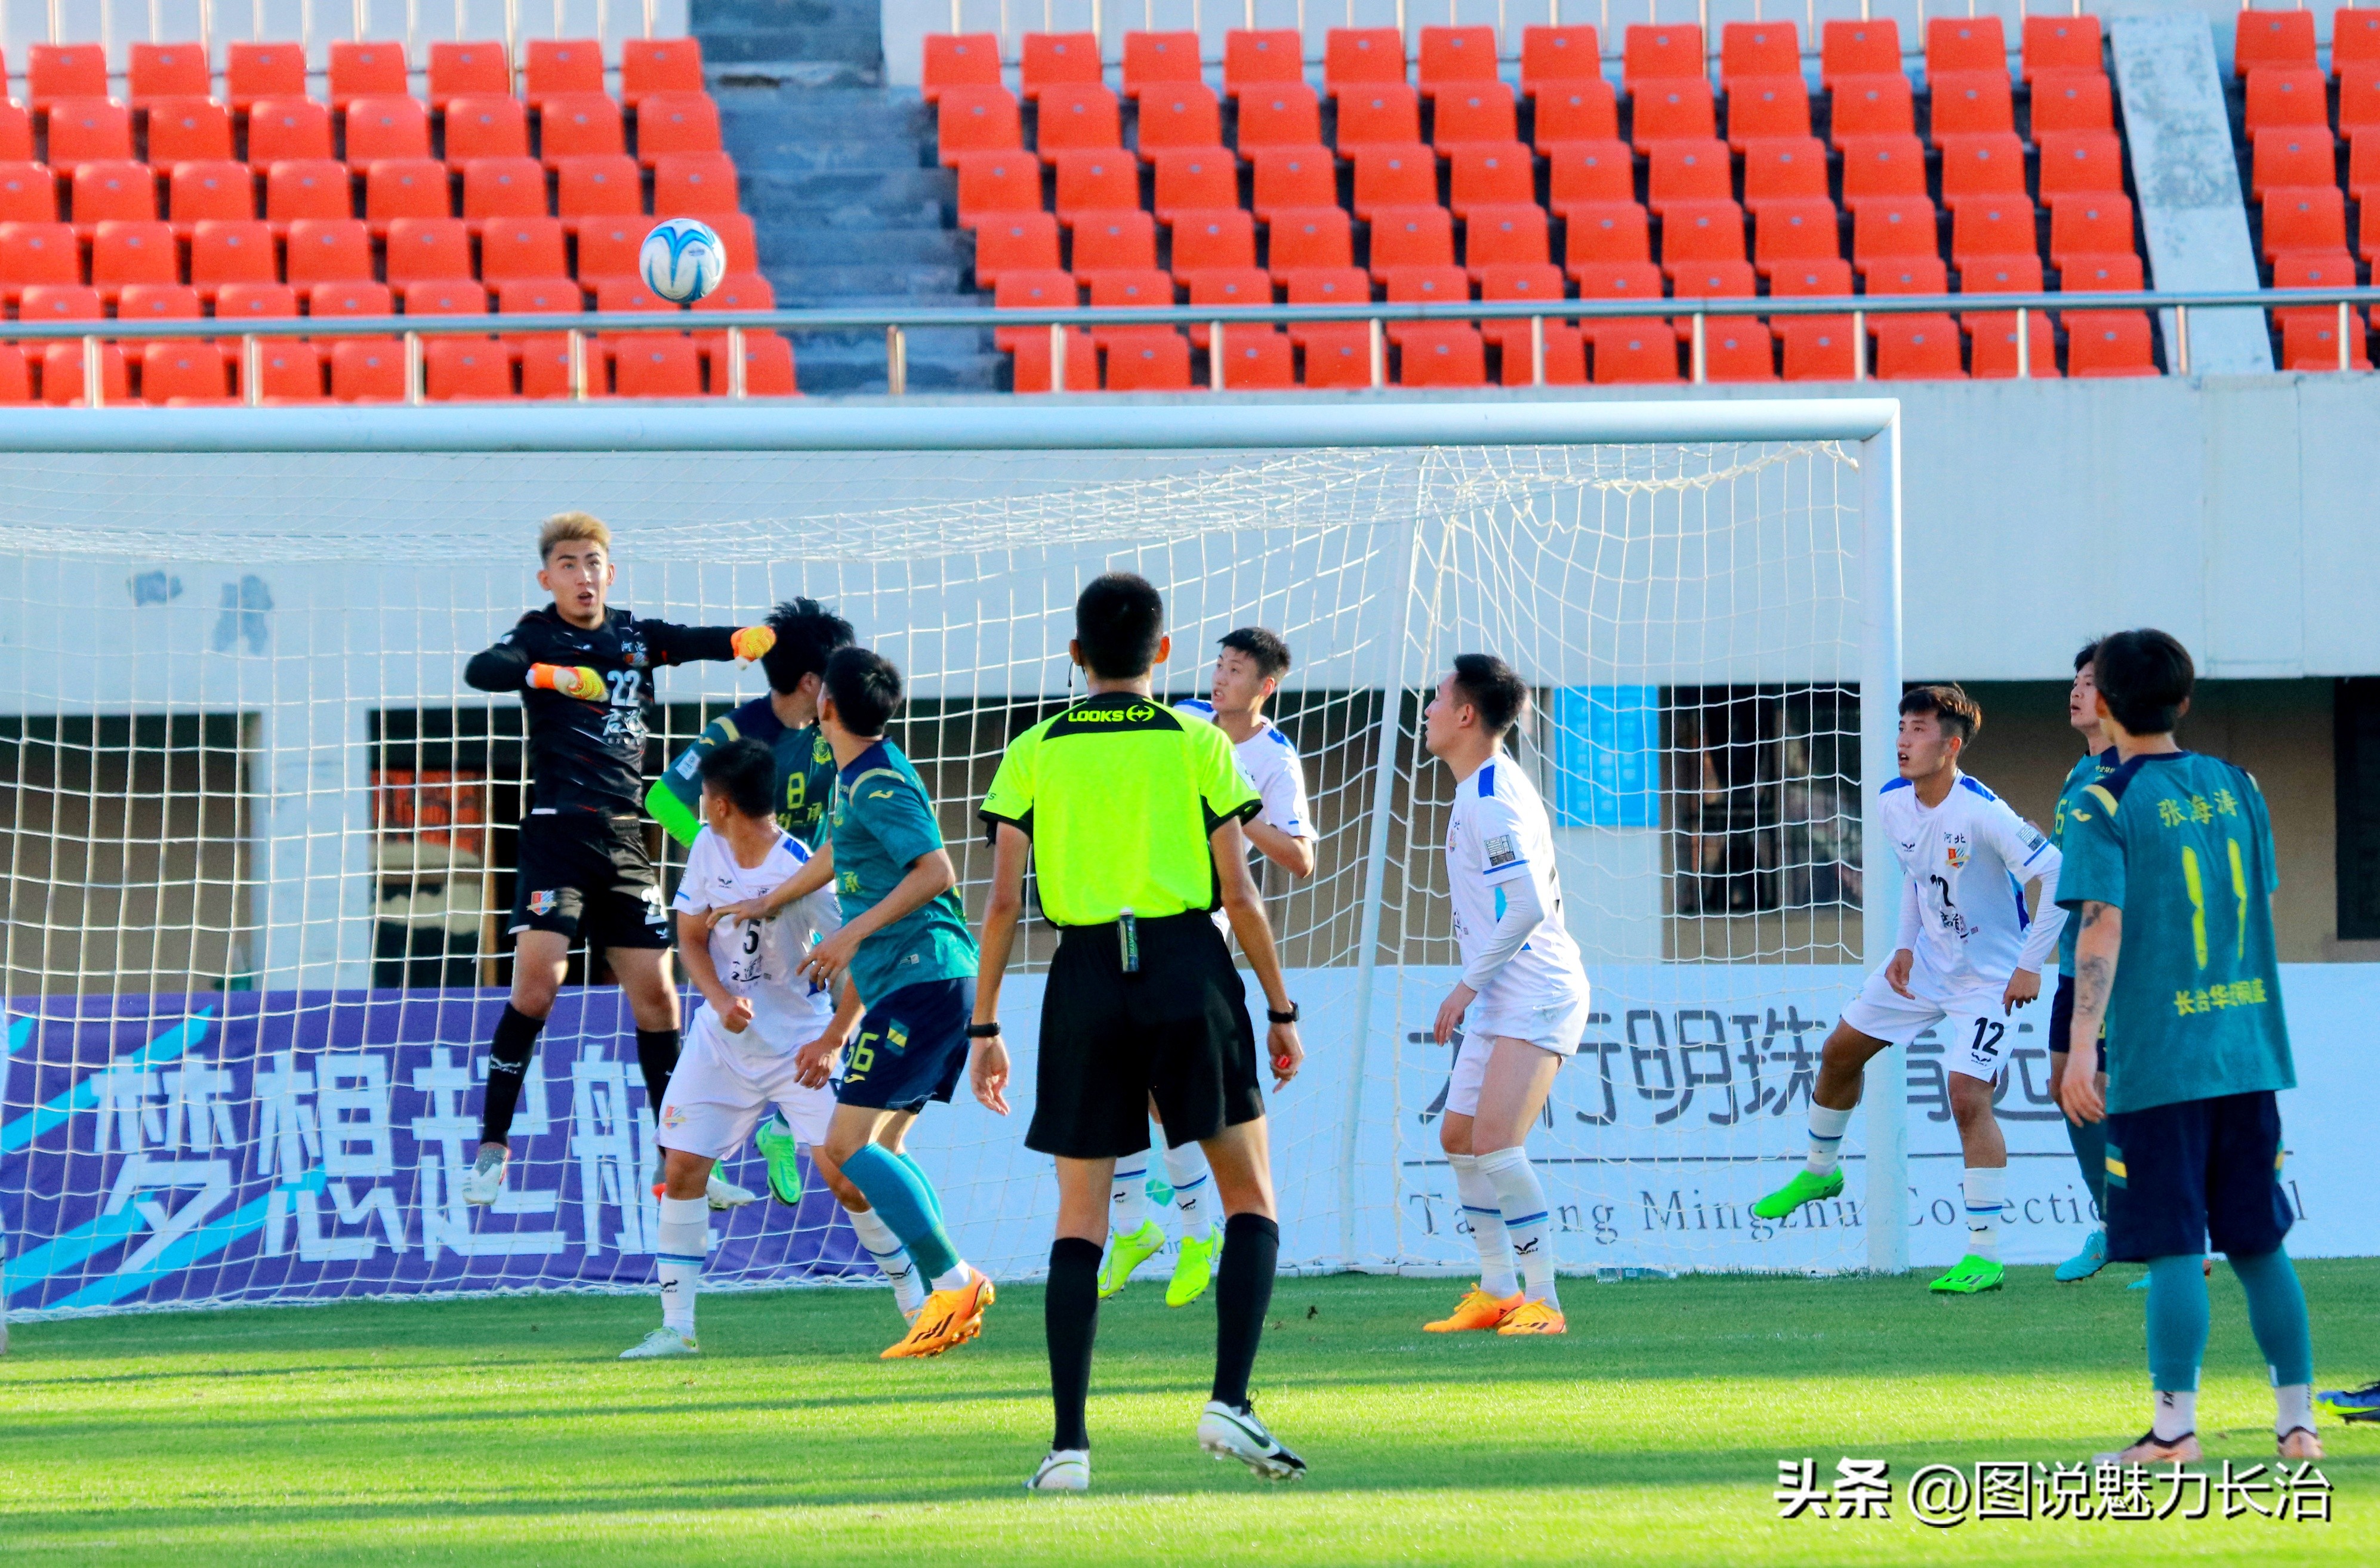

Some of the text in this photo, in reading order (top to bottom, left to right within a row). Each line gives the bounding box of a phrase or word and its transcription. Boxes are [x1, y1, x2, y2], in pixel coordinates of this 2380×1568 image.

[607, 670, 640, 707] 22
[1068, 711, 1124, 723] LOOKS
[787, 772, 805, 810] 8
[2157, 788, 2239, 828] 张海涛
[1943, 832, 1966, 844] 河北
[2182, 837, 2248, 971] 11
[742, 919, 762, 955] 5
[1972, 1017, 2005, 1057] 12
[1410, 1193, 1618, 1245] Tang
